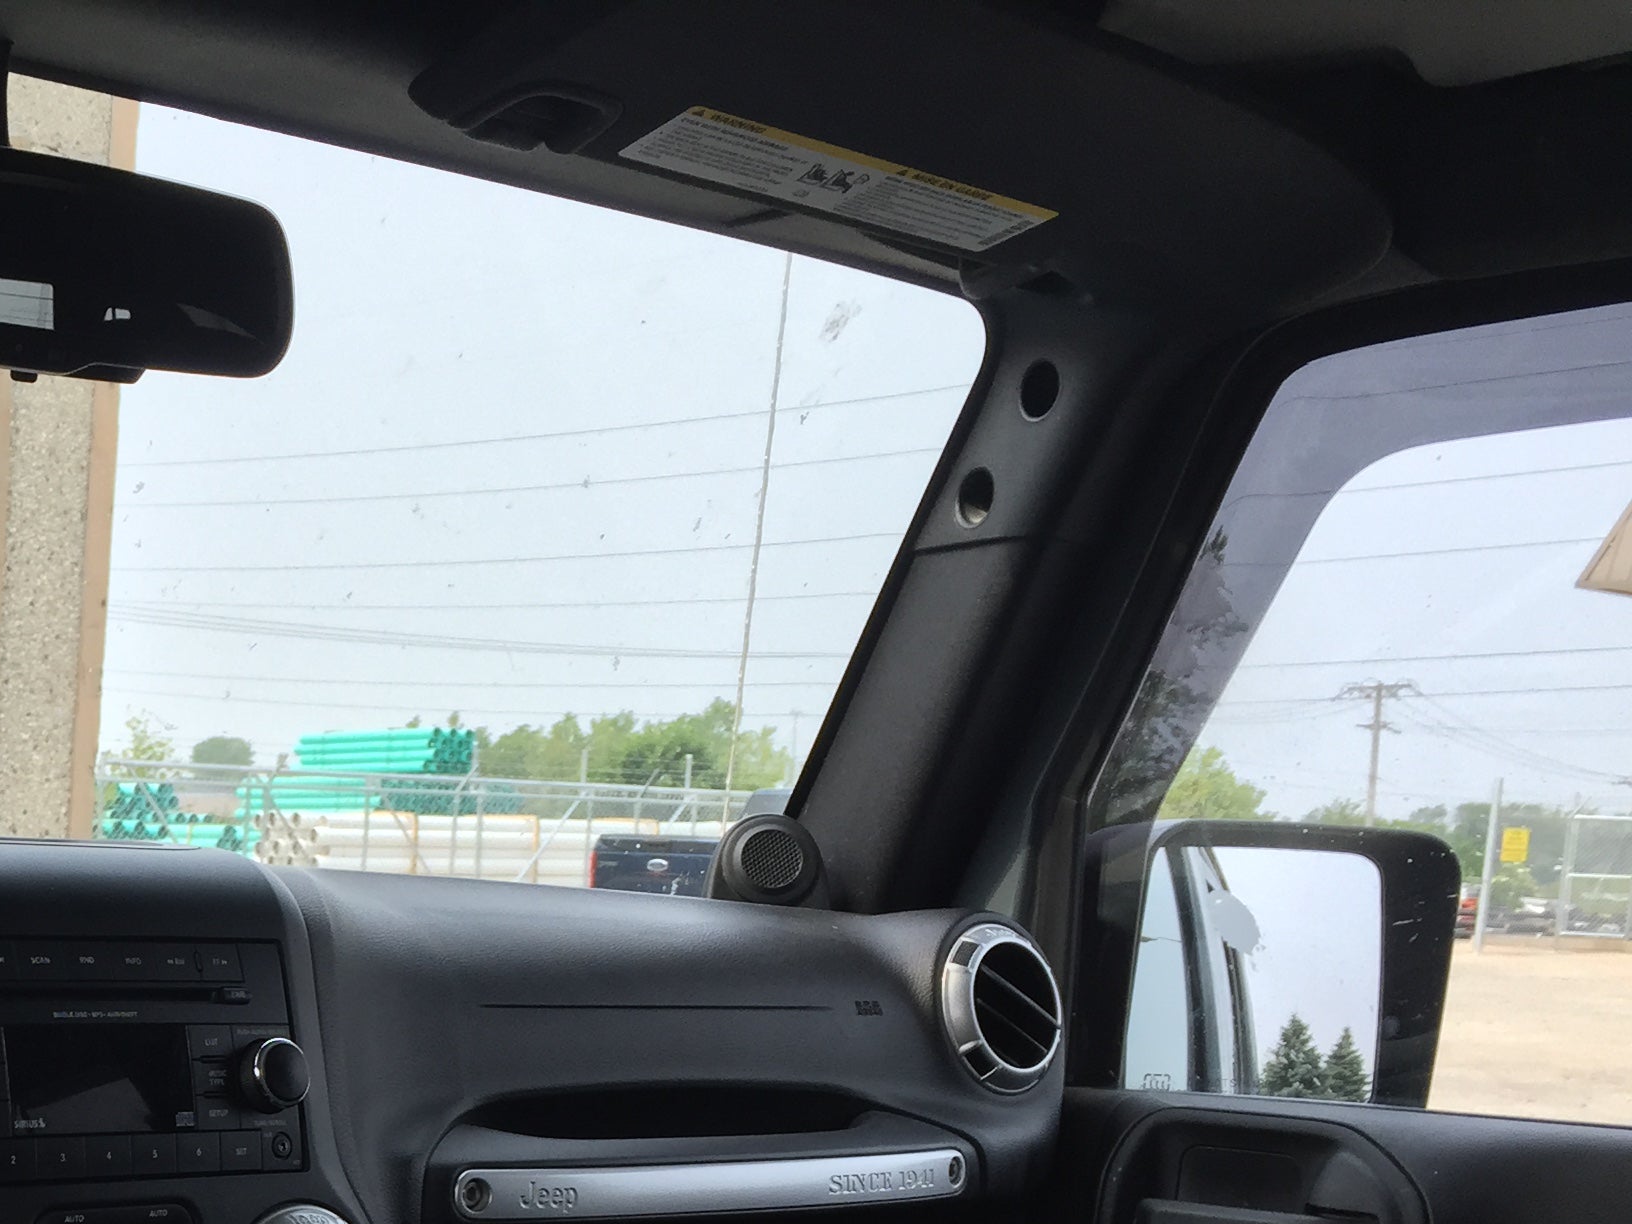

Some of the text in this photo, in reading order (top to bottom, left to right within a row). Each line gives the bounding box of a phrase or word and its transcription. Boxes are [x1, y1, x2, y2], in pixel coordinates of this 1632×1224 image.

[710, 113, 767, 135] WARNING
[105, 1151, 113, 1161] 4
[151, 1149, 159, 1159] 5
[195, 1147, 203, 1157] 6
[9, 1155, 17, 1165] 2
[59, 1153, 67, 1163] 3
[828, 1168, 935, 1196] SINCE 1941
[519, 1180, 579, 1214] Jeep
[148, 1208, 168, 1218] AUTO
[64, 1214, 86, 1224] AUTO
